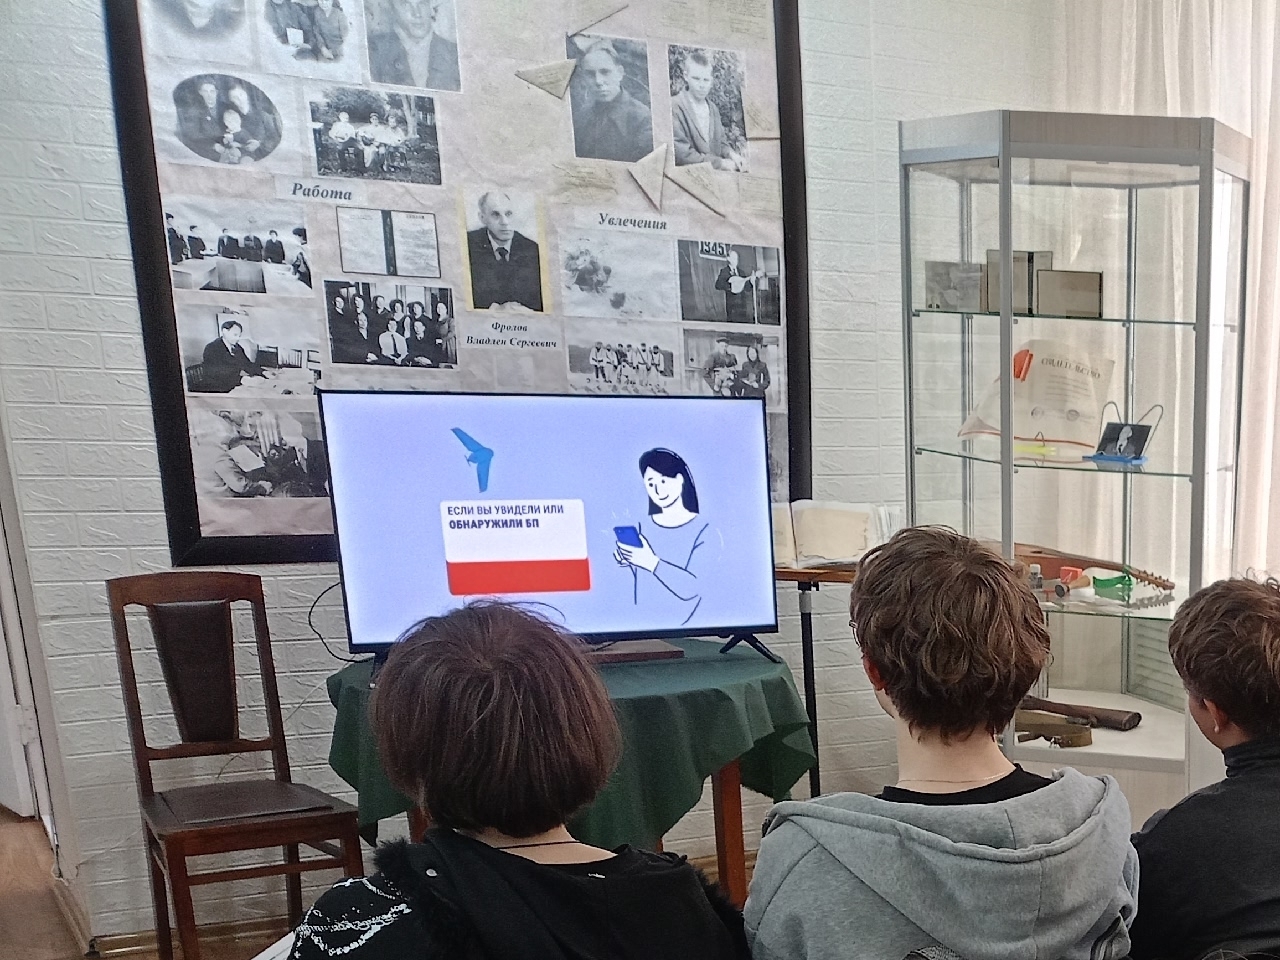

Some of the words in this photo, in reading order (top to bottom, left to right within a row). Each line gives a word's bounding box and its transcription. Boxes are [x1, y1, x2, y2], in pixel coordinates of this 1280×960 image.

[292, 182, 352, 200] Работа
[598, 212, 667, 230] Увлечения
[491, 322, 528, 333] Фролов
[466, 336, 507, 347] Владлен
[509, 337, 557, 348] Сергеевич
[448, 506, 474, 515] ЕСЛИ
[477, 506, 492, 515] ВЫ
[495, 505, 541, 516] УВИДЕЛИ
[543, 505, 564, 514] ИЛИ
[449, 519, 523, 529] ОБНАРУЖИЛИ
[526, 519, 540, 528] БП
